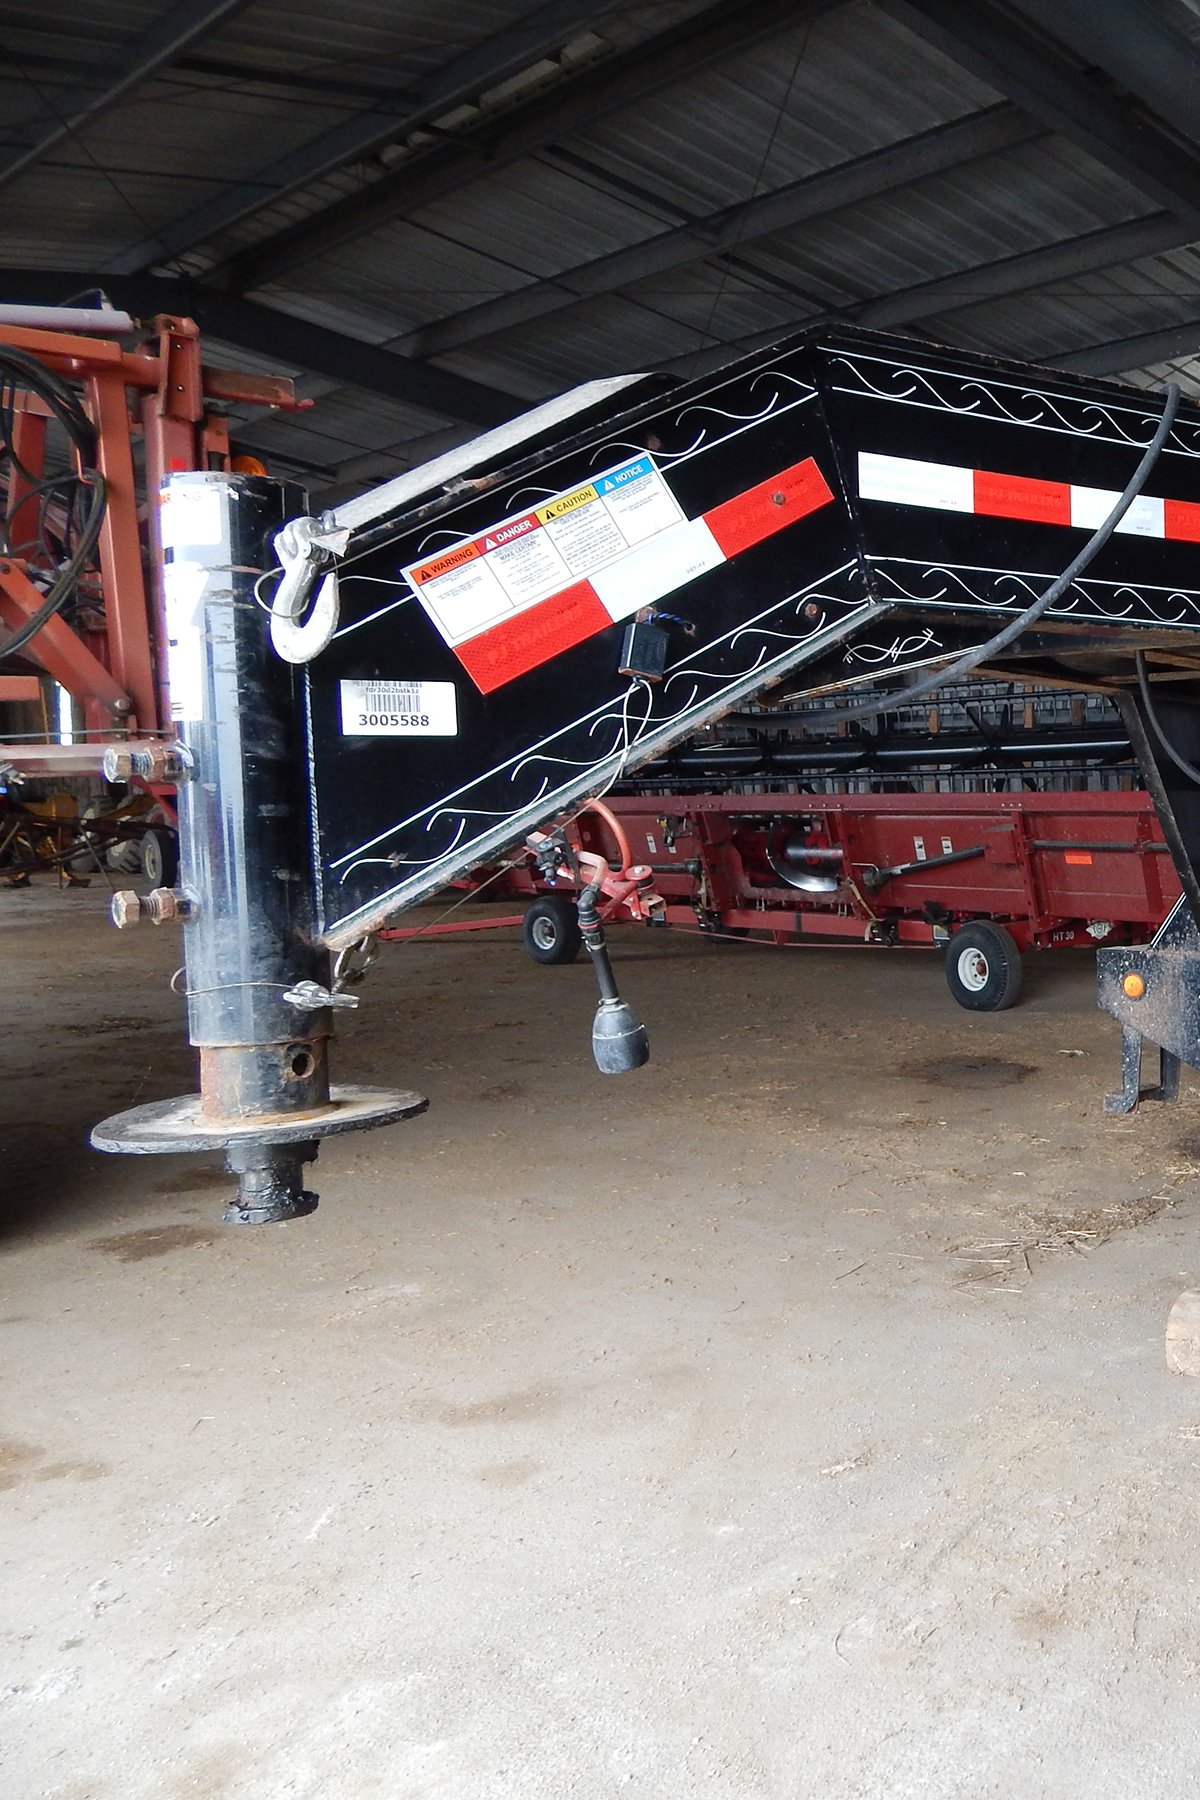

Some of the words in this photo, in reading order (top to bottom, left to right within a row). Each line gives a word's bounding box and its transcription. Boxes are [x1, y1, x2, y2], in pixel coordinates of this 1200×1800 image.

[614, 464, 644, 484] NOTICE
[556, 490, 593, 512] CAUTION
[495, 520, 533, 543] DANGER
[431, 548, 474, 574] WARNING
[359, 714, 430, 726] 3005588
